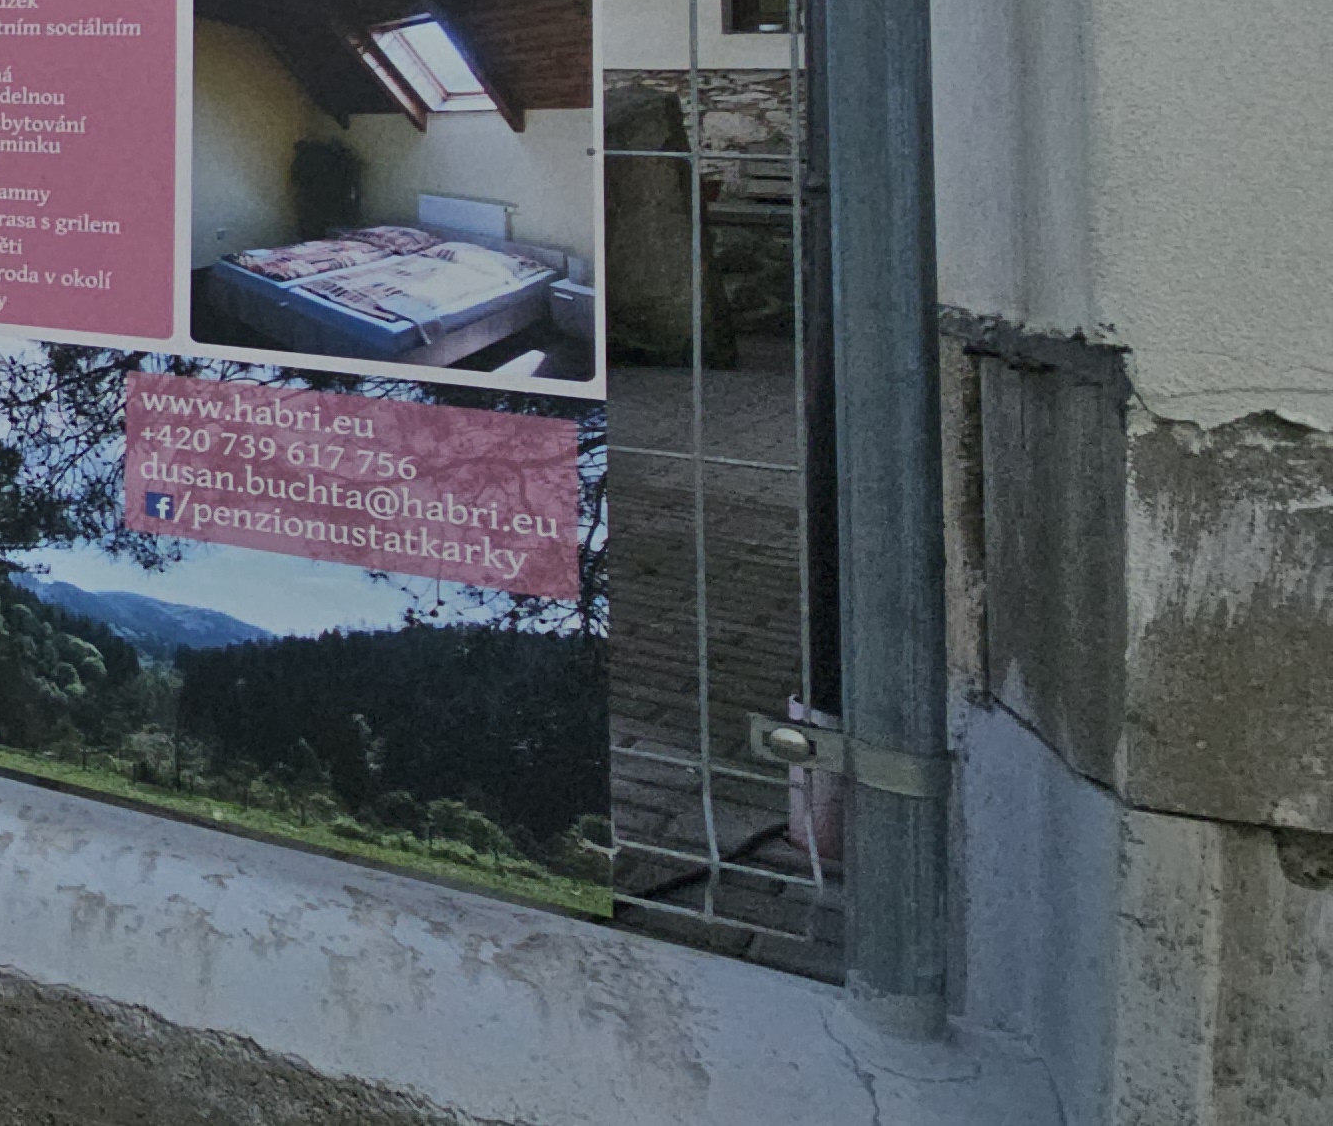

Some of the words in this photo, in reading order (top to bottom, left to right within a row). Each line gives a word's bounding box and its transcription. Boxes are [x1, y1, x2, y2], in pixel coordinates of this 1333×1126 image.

[46, 18, 141, 37] sociálním
[41, 218, 50, 230] s
[55, 213, 121, 236] grilem
[44, 272, 55, 284] v
[61, 270, 111, 289] okolí
[141, 389, 375, 439] www.habri.eu
[140, 425, 211, 453] +420
[221, 432, 276, 461] 739
[286, 441, 345, 471] 617
[356, 450, 417, 480] 756
[140, 452, 558, 539] dusan.buchta@habri.eu
